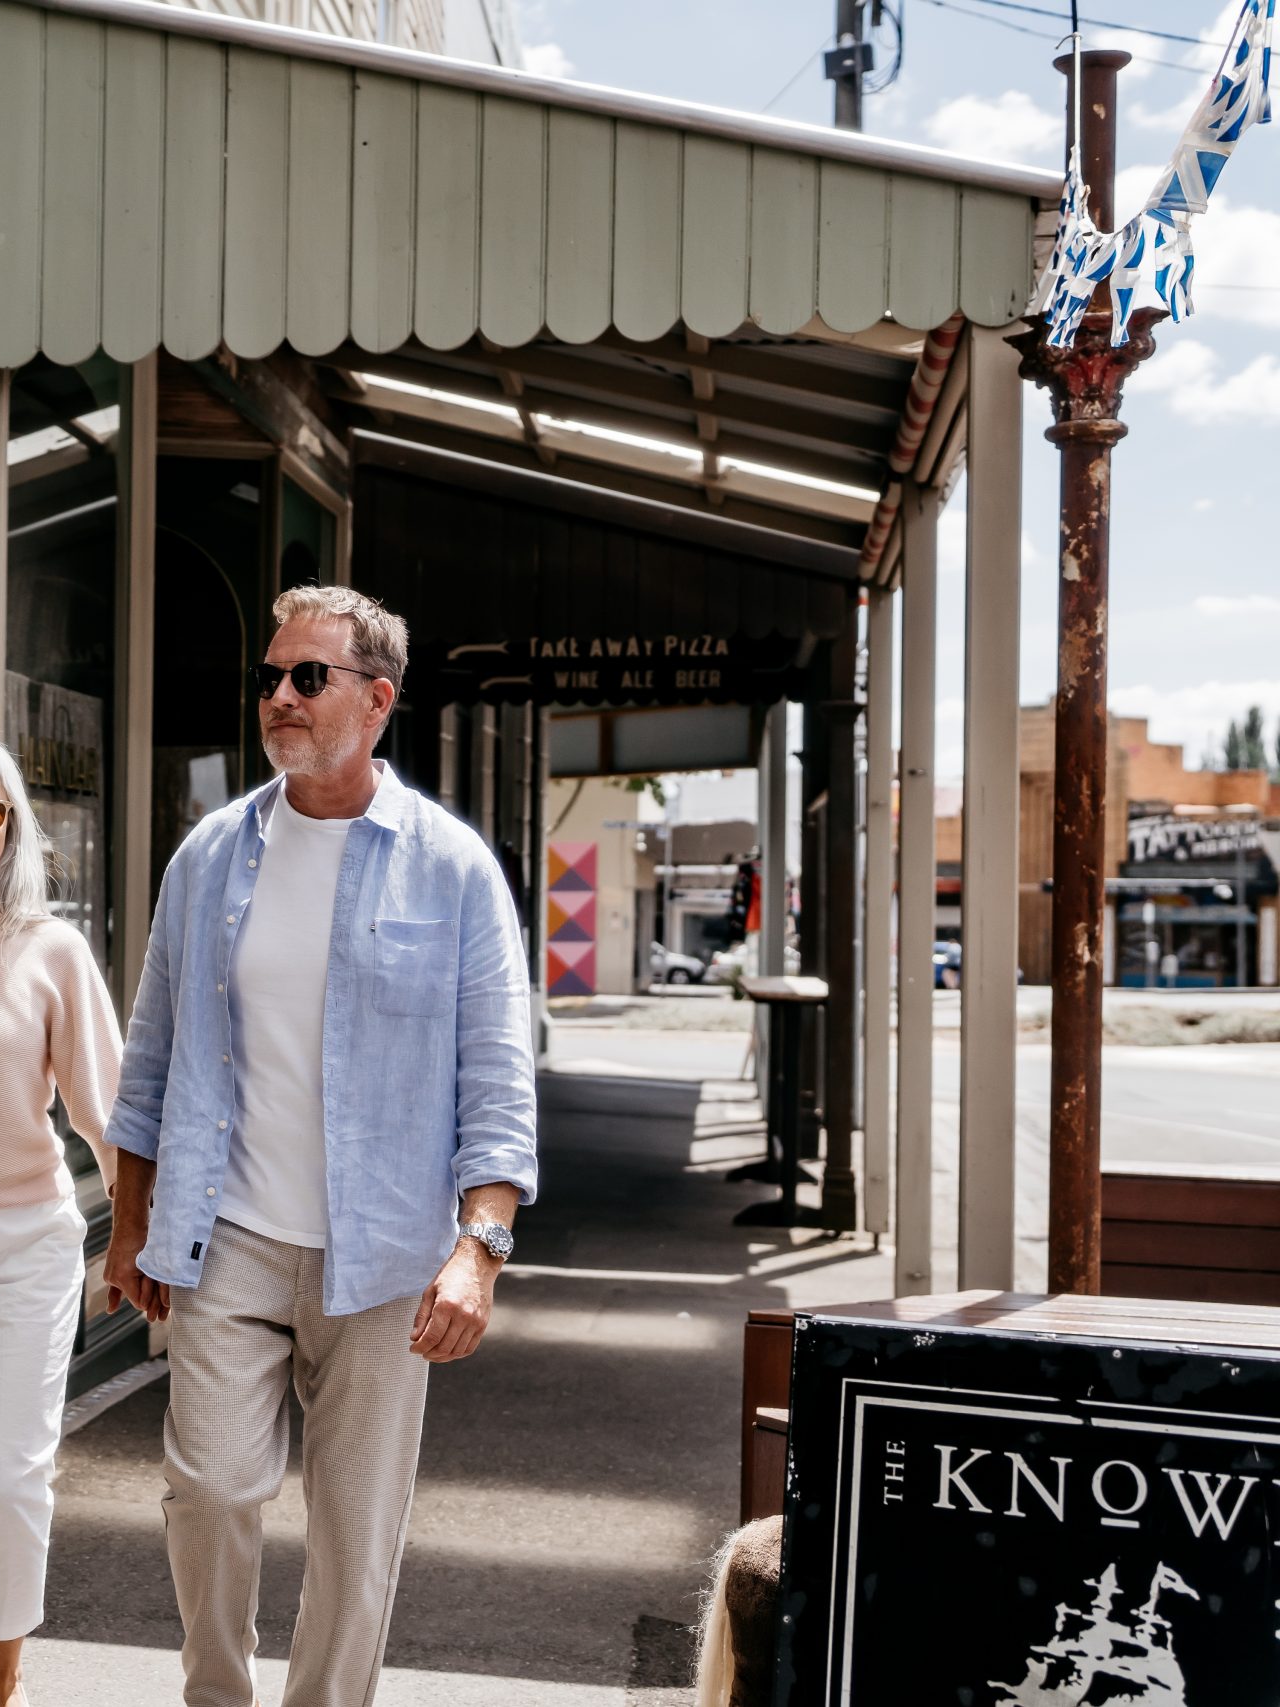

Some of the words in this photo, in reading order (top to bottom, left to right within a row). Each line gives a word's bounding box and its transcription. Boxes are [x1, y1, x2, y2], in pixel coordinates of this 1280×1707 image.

[530, 637, 579, 657] TAKE
[590, 634, 654, 657] AWAY
[664, 635, 729, 656] PIZZA
[554, 670, 599, 688] WINE
[621, 670, 654, 688] ALE
[676, 669, 721, 688] BEER
[883, 1439, 906, 1505] THE
[932, 1444, 1280, 1545] KNOW
